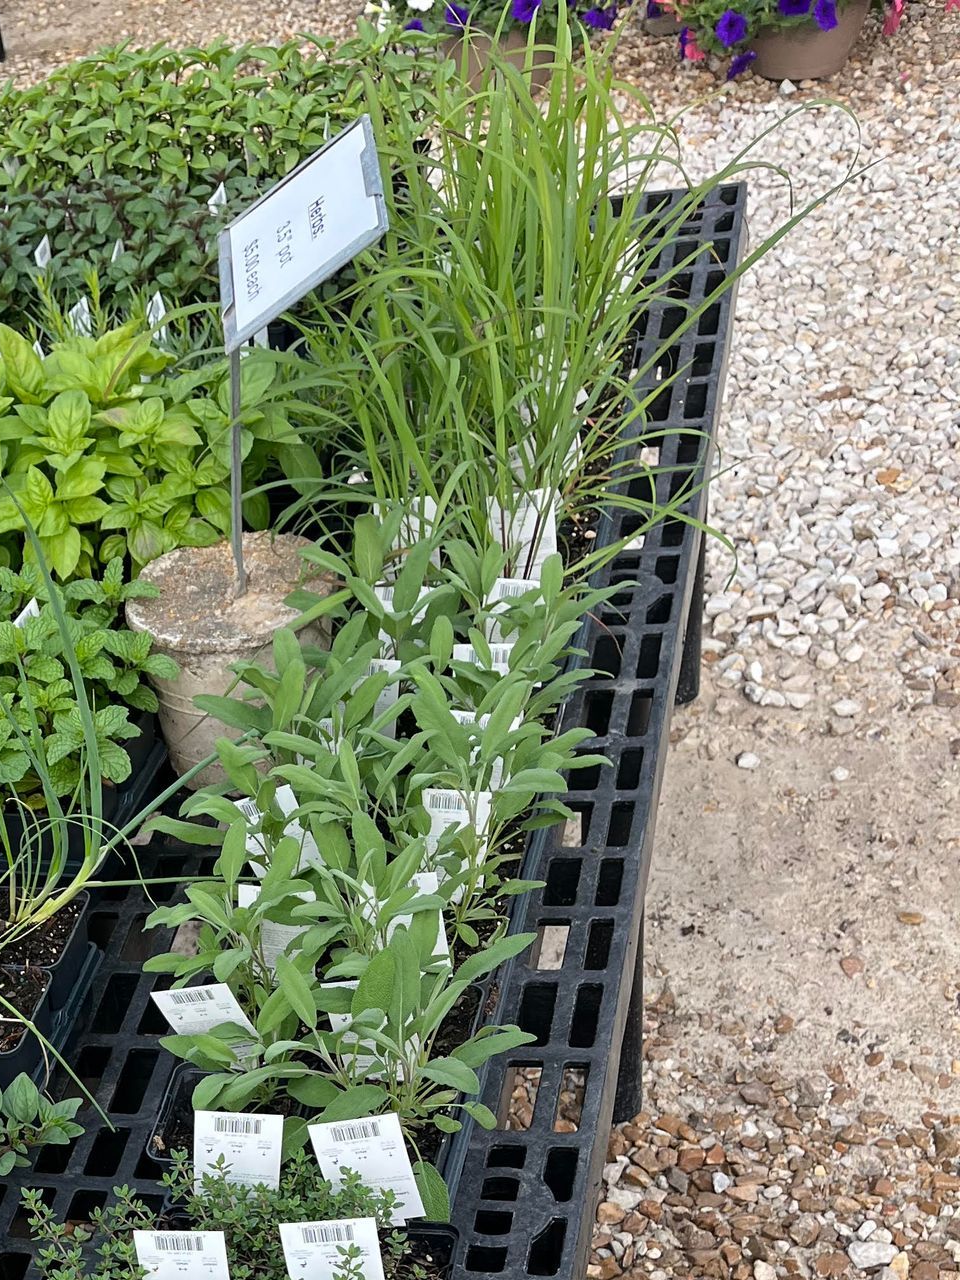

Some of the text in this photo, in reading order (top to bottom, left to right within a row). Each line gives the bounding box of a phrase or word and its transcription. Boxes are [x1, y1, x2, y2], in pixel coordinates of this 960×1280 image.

[308, 195, 327, 240] Herbs:
[275, 244, 295, 269] pot
[246, 271, 262, 302] each
